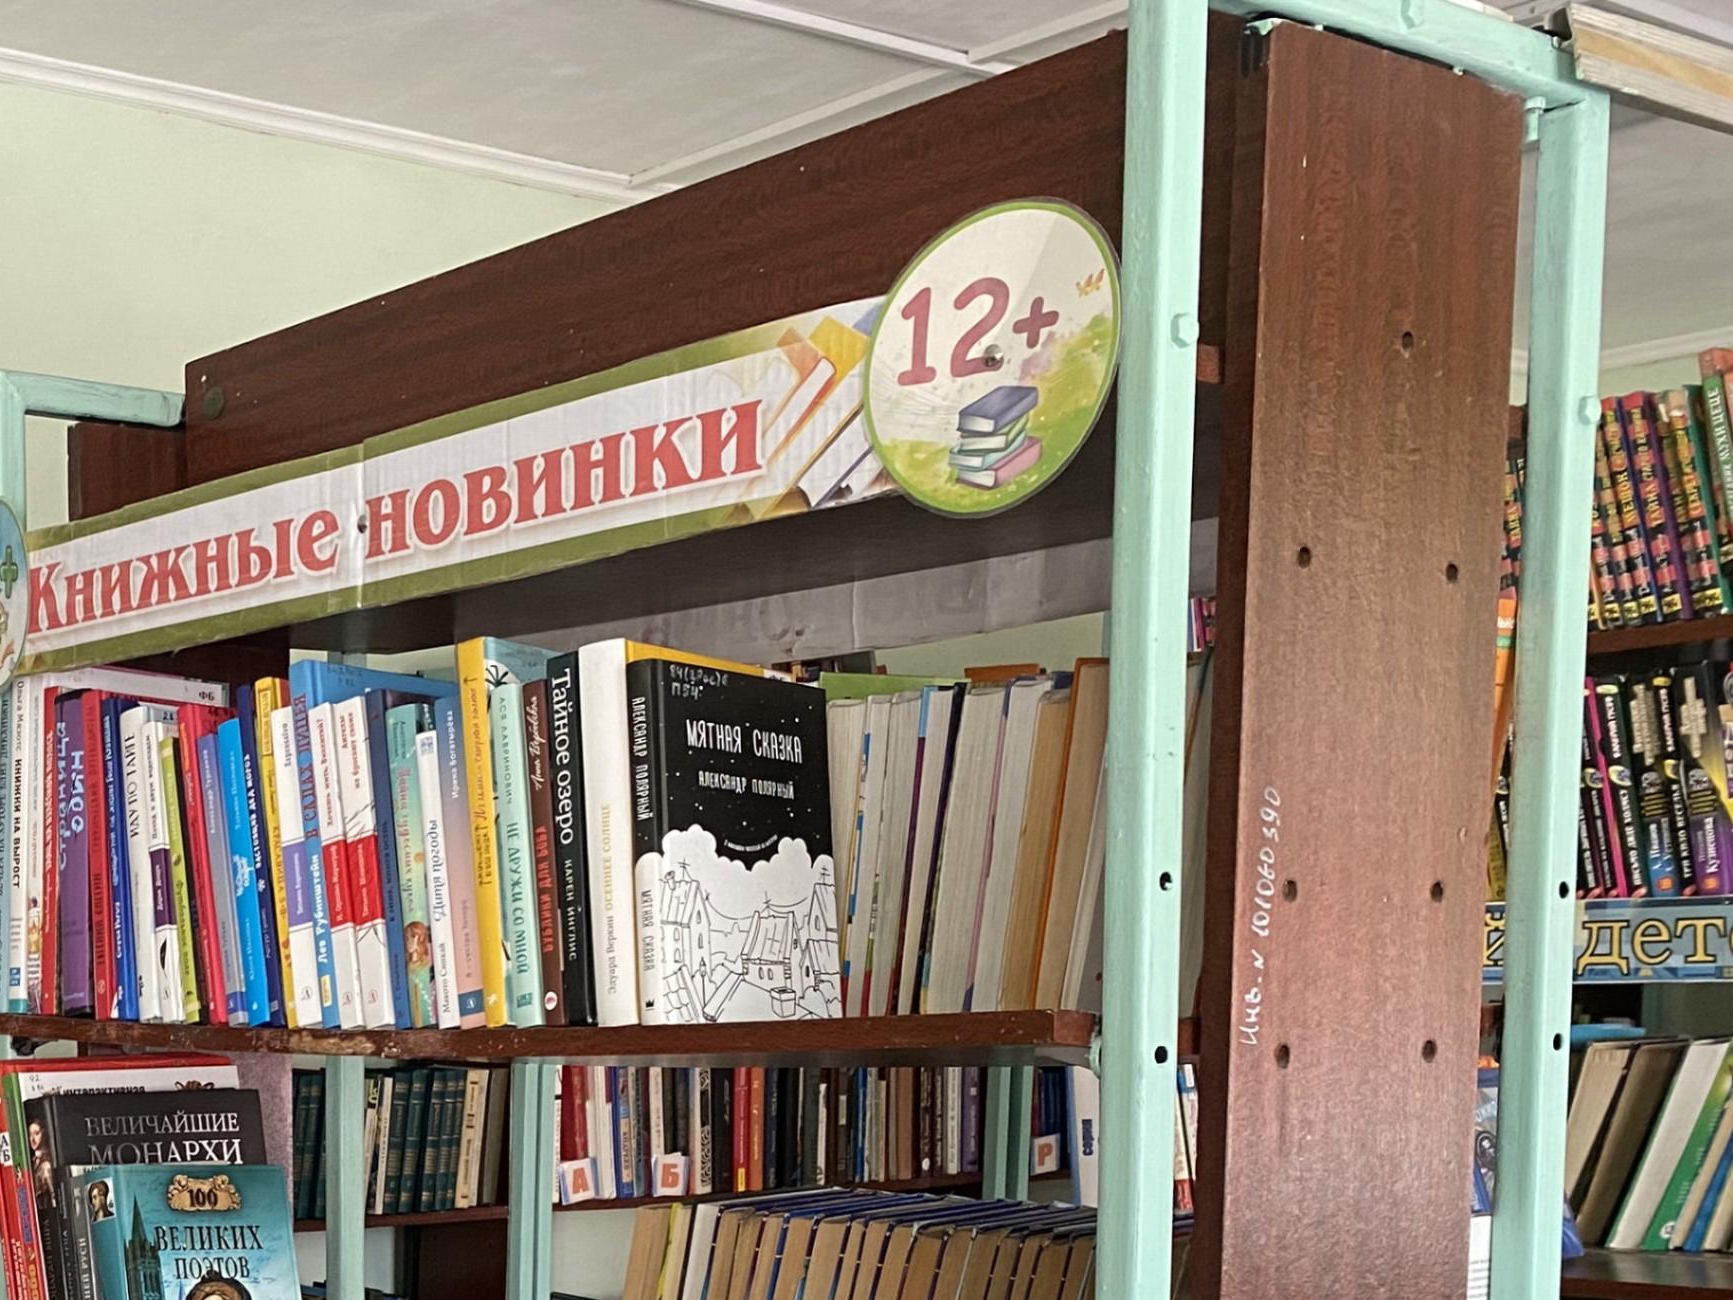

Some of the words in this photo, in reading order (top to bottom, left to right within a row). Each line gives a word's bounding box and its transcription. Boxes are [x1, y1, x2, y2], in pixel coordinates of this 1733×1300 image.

[900, 277, 1060, 386] 12+
[1707, 387, 1724, 425] ЦЕЦЕ
[28, 509, 338, 638] Книжные
[364, 399, 764, 560] новинки
[1646, 483, 1663, 525] ТАЙНА
[294, 692, 313, 752] ЛИЦЕЯ
[498, 696, 507, 722] АСЯ
[550, 668, 574, 767] Тайное
[630, 696, 649, 758] АЛЕКСАНДР
[124, 733, 136, 775] ТАЙГЕ
[686, 719, 742, 753] МЯТНАЯ
[752, 729, 802, 764] СКАЗКА
[243, 753, 254, 786] МОРОЗ
[450, 767, 460, 799] Ирина
[500, 725, 513, 805] ЛАВРИНОВИЧ
[698, 770, 747, 794] АЛЕКСАНДР
[752, 778, 794, 799] ПОЛЯРНЫЙ
[13, 759, 22, 812] КНИЖКИ
[127, 781, 137, 806] ПО
[247, 788, 256, 809] ДЕД
[299, 765, 317, 820] САДАХ
[633, 763, 654, 821] ПОЛЯРНЫЙ
[13, 816, 21, 834] НА
[128, 809, 139, 837] ИДУ
[555, 771, 575, 845] озеро
[1672, 784, 1686, 827] ВЕСЕЛЬЯ
[249, 813, 262, 869] НАСТОЯЩИЙ
[304, 828, 317, 838] В
[426, 819, 443, 870] погоды
[505, 822, 519, 843] НЕ
[600, 804, 611, 853] СОЛНЦЕ
[1678, 829, 1689, 856] КИЛО
[1705, 816, 1720, 873] Кузнецова
[12, 838, 21, 888] ВЫРОСТ
[507, 845, 522, 903] ДРУЖИ
[538, 860, 553, 889] ДЛЯ
[563, 859, 574, 901] КАРЕН
[1682, 859, 1692, 878] ТРИ
[311, 854, 326, 935] Рубинштейн
[640, 890, 653, 929] МЯТНАЯ
[510, 907, 524, 927] СО
[539, 892, 555, 951] БУБЛИКИ
[565, 906, 577, 962] ИНГЛИС
[604, 915, 616, 954] Веркин
[315, 940, 328, 964] Лев
[513, 929, 530, 975] МНОЙ
[641, 935, 656, 972] СКАЗКА
[1577, 917, 1733, 976] дет
[606, 955, 617, 994] Эдуард
[84, 1110, 240, 1137] ВЕЛИЧАЙШИЕ
[88, 1138, 243, 1165] МОНАРХИ
[572, 1168, 589, 1194] А
[661, 1164, 679, 1188] Б
[188, 1188, 218, 1208] 100
[78, 1237, 88, 1271] РУСИ
[154, 1225, 263, 1251] ВЕЛИКИХ
[174, 1257, 250, 1279] ПОЭТОВ
